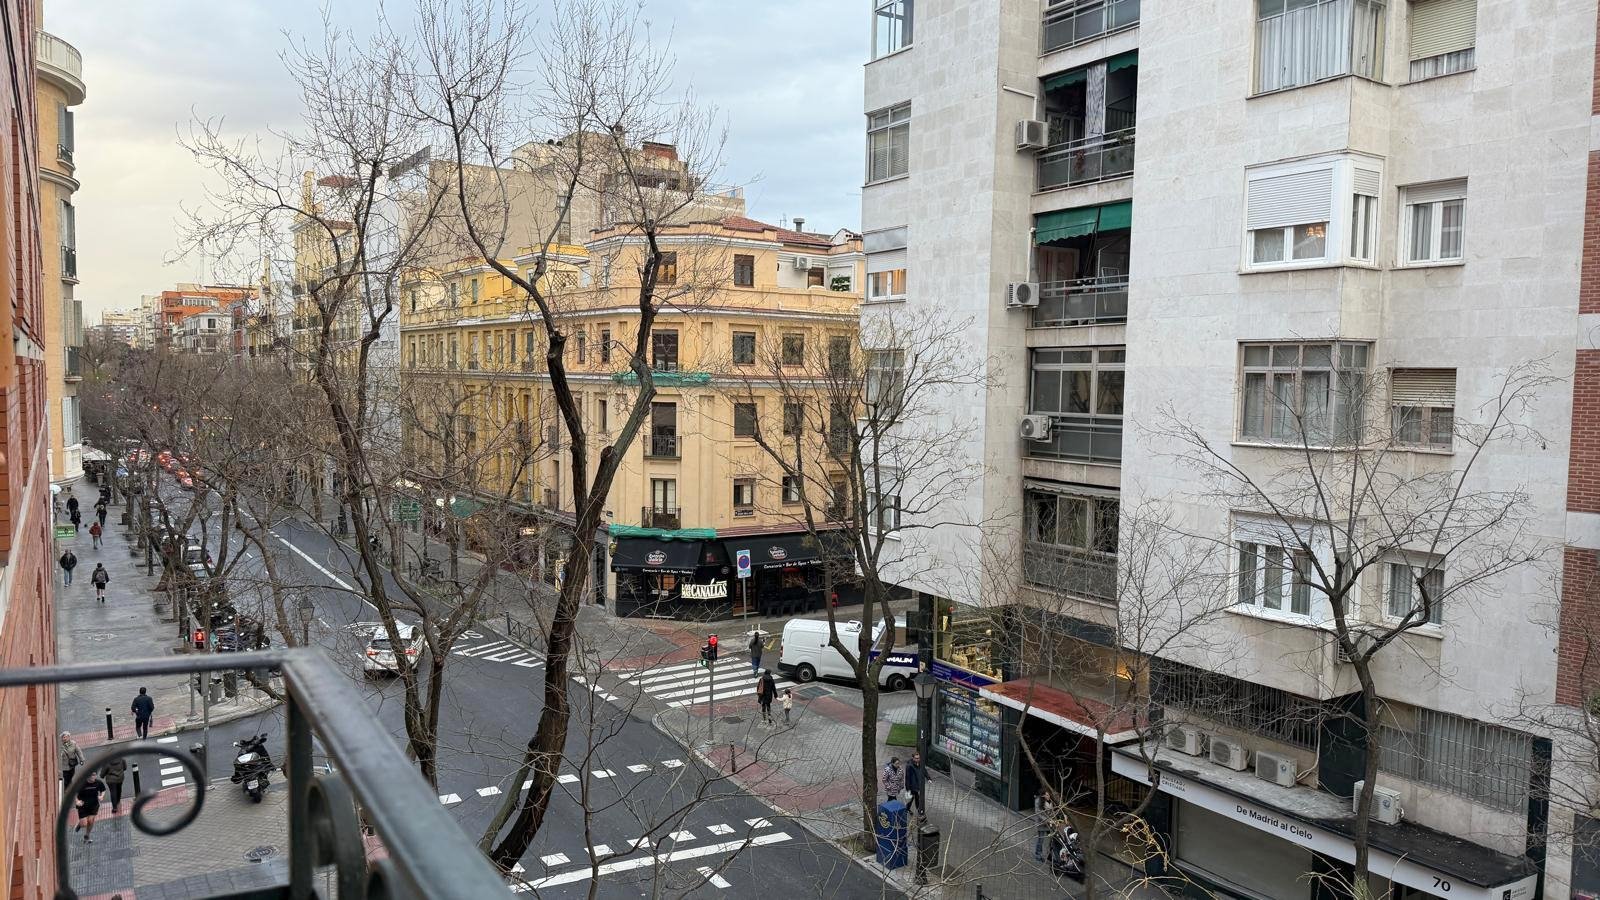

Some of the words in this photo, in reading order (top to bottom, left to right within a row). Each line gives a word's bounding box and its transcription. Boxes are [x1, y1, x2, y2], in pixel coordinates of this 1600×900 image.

[1236, 805, 1248, 815] De
[1249, 810, 1279, 827] Madrid
[1280, 823, 1288, 831] al
[1289, 825, 1313, 840] Cielo
[1432, 875, 1451, 892] 70
